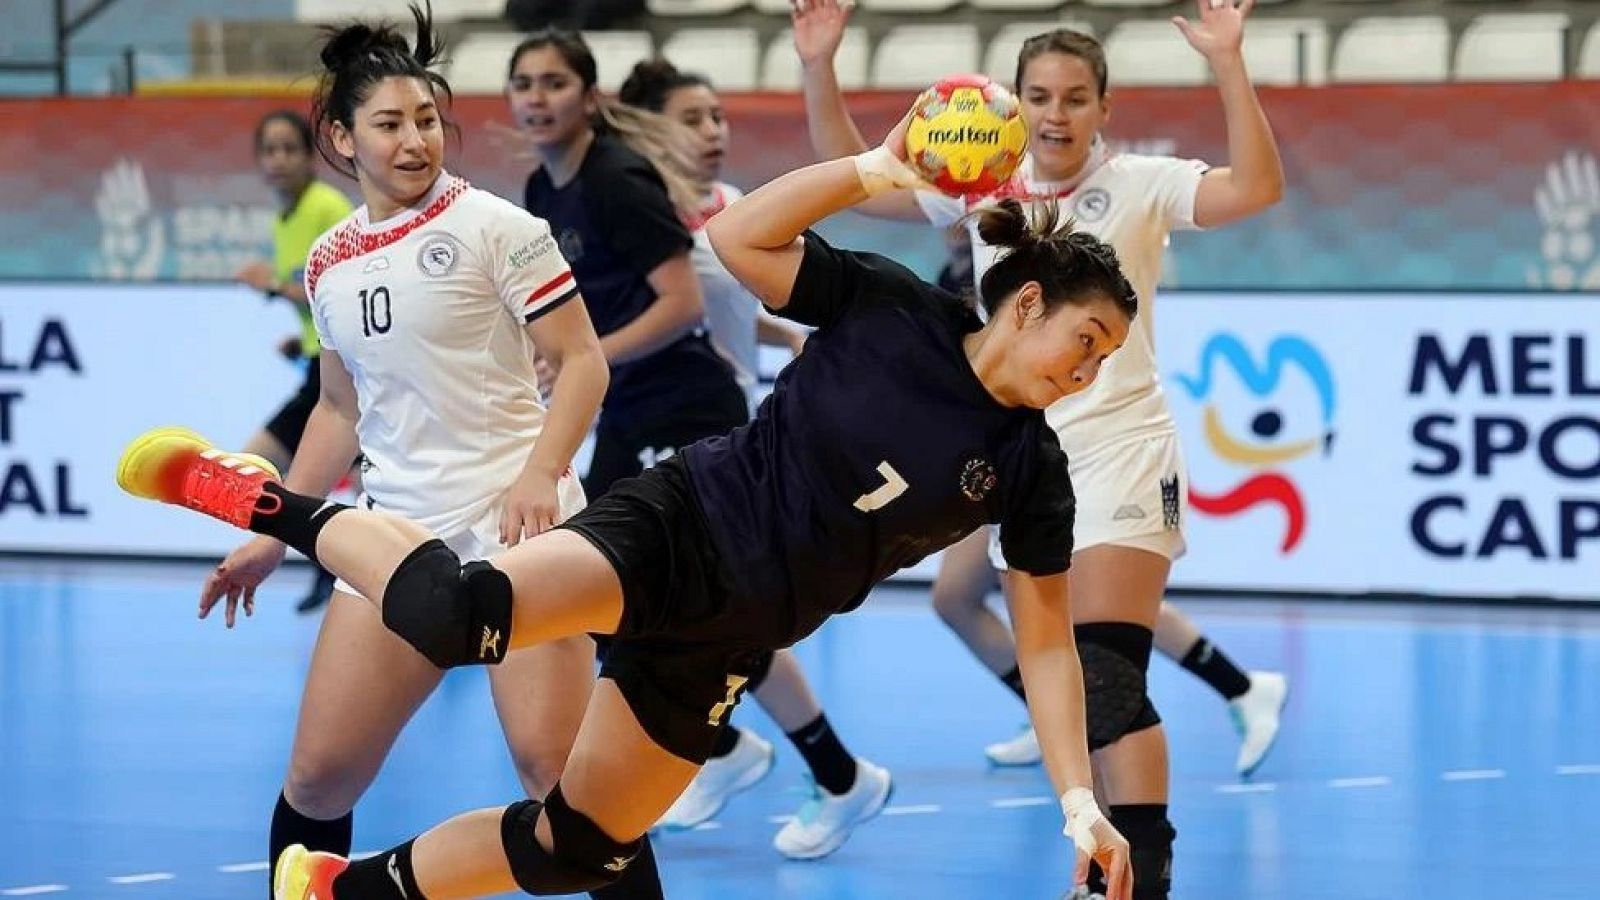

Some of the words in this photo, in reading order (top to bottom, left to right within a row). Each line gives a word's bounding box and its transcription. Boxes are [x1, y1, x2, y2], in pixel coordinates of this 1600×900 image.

[928, 126, 999, 144] molten
[358, 286, 392, 337] 10
[1408, 334, 1600, 395] MEL
[1411, 413, 1600, 480] SPO
[0, 463, 88, 516] AL
[853, 460, 909, 512] 7
[1409, 494, 1600, 559] CAP
[708, 674, 749, 726] 7
